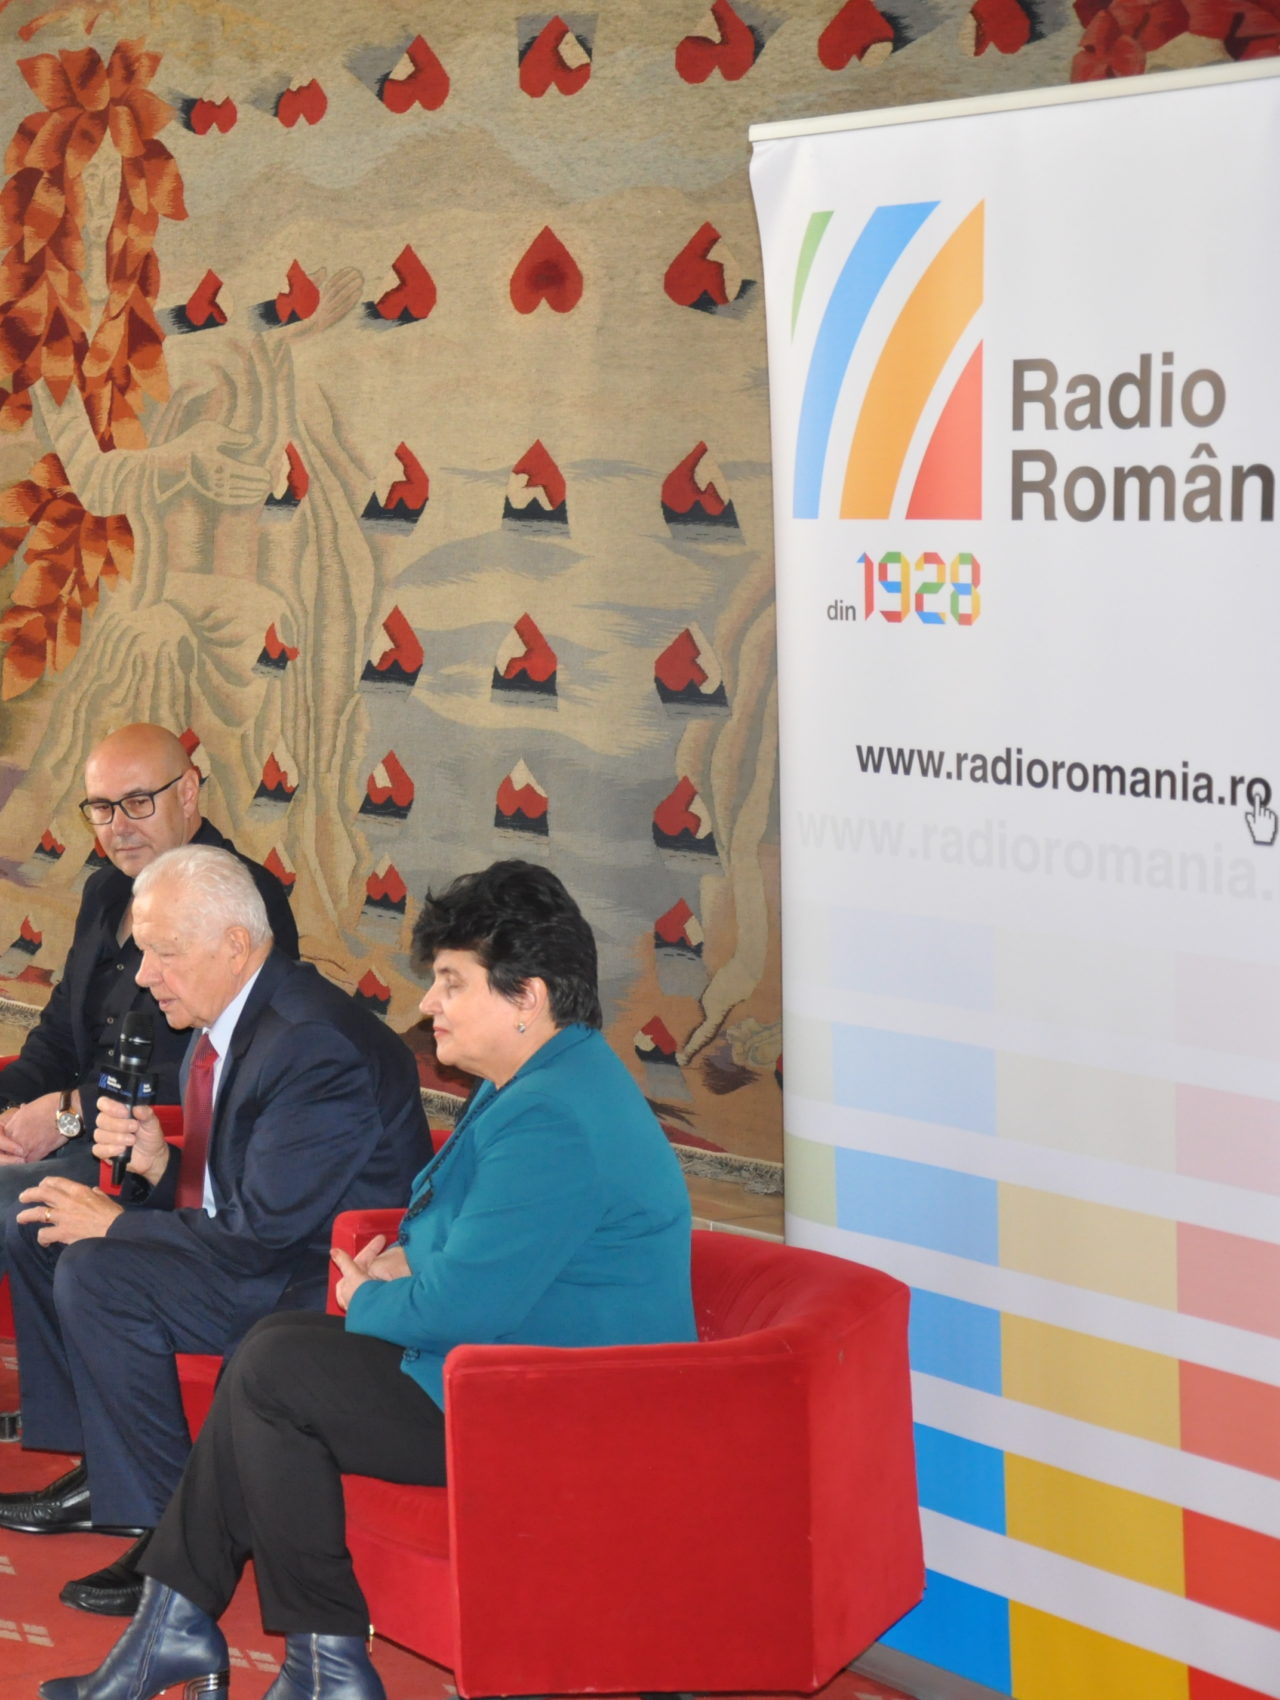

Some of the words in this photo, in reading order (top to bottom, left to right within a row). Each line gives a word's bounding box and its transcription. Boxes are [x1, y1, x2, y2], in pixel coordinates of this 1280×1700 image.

[1010, 350, 1227, 432] Radio
[1009, 442, 1276, 523] Român
[826, 600, 857, 622] din
[856, 551, 982, 626] 1928
[855, 743, 1273, 808] www.radioromania.ro
